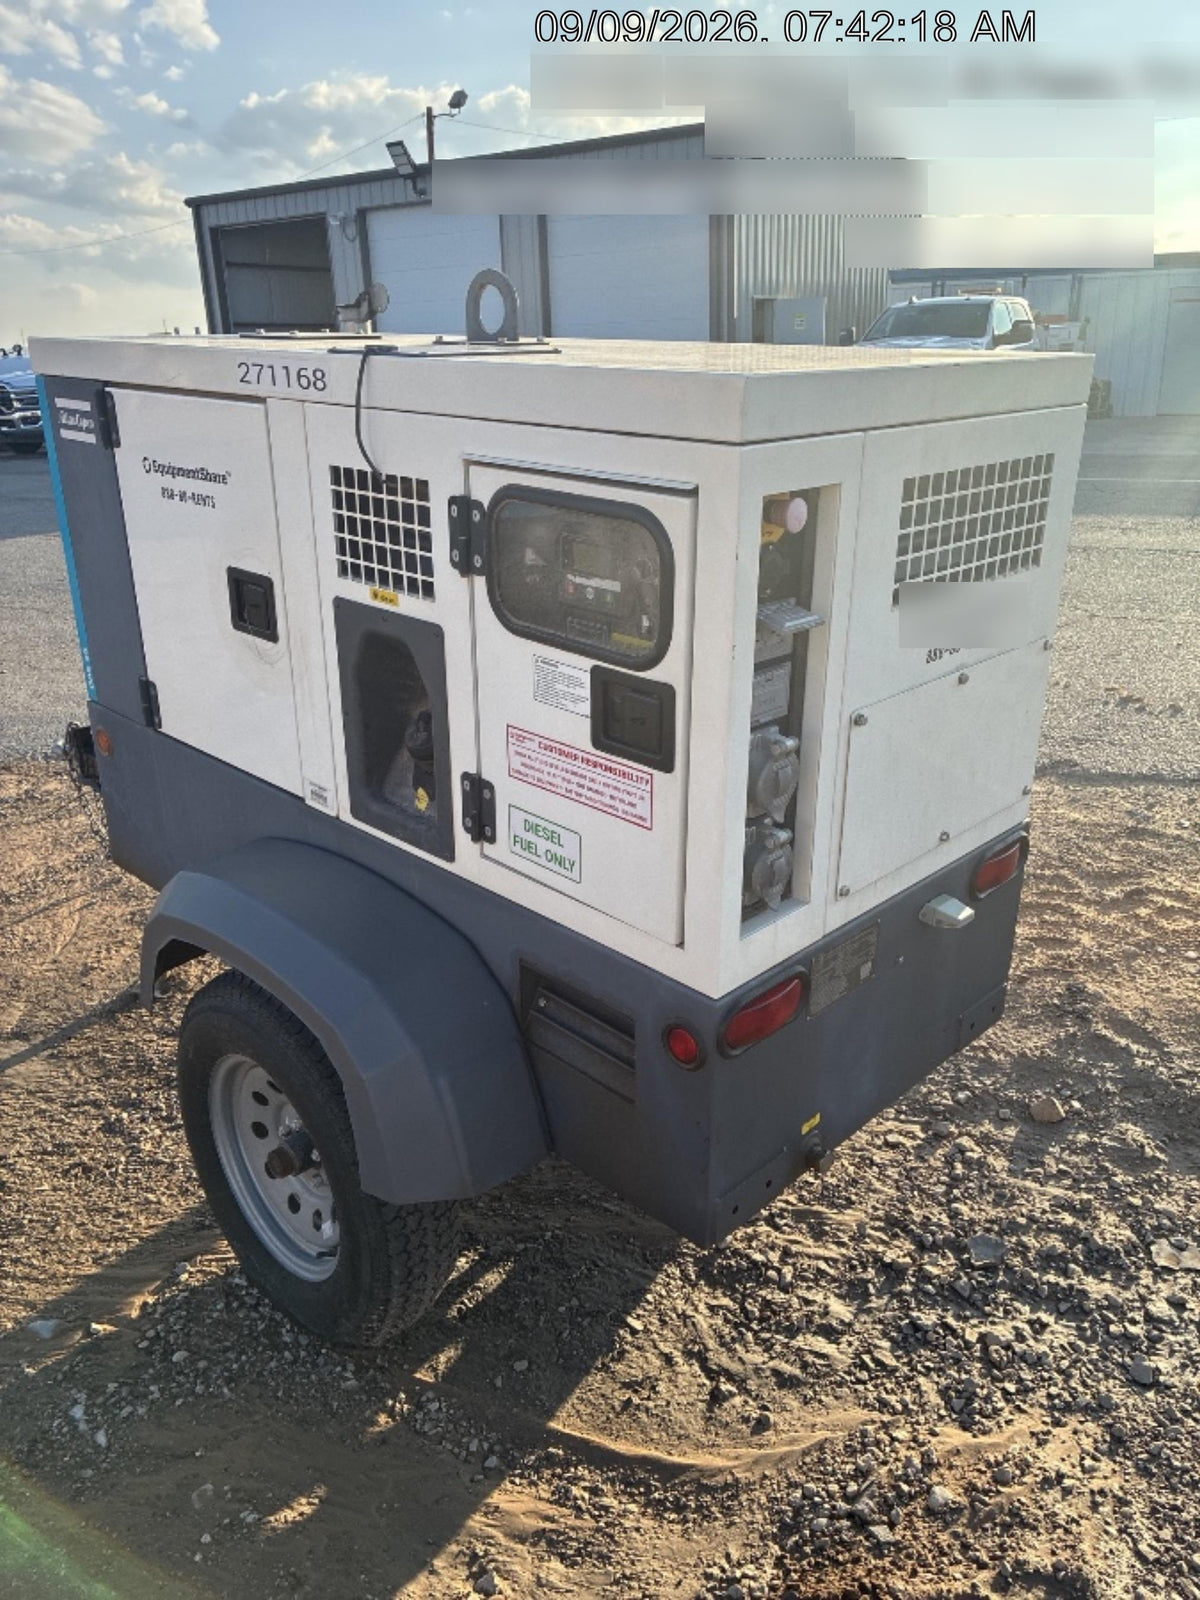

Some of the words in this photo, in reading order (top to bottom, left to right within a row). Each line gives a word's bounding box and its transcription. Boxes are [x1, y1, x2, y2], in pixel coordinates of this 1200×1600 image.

[238, 362, 327, 392] 271168
[537, 740, 580, 763] CUSTOMER
[580, 755, 650, 787] RESPONSIBILITY
[523, 818, 565, 849] DIESEL
[512, 835, 543, 860] FUEL
[545, 848, 577, 874] ONLY
